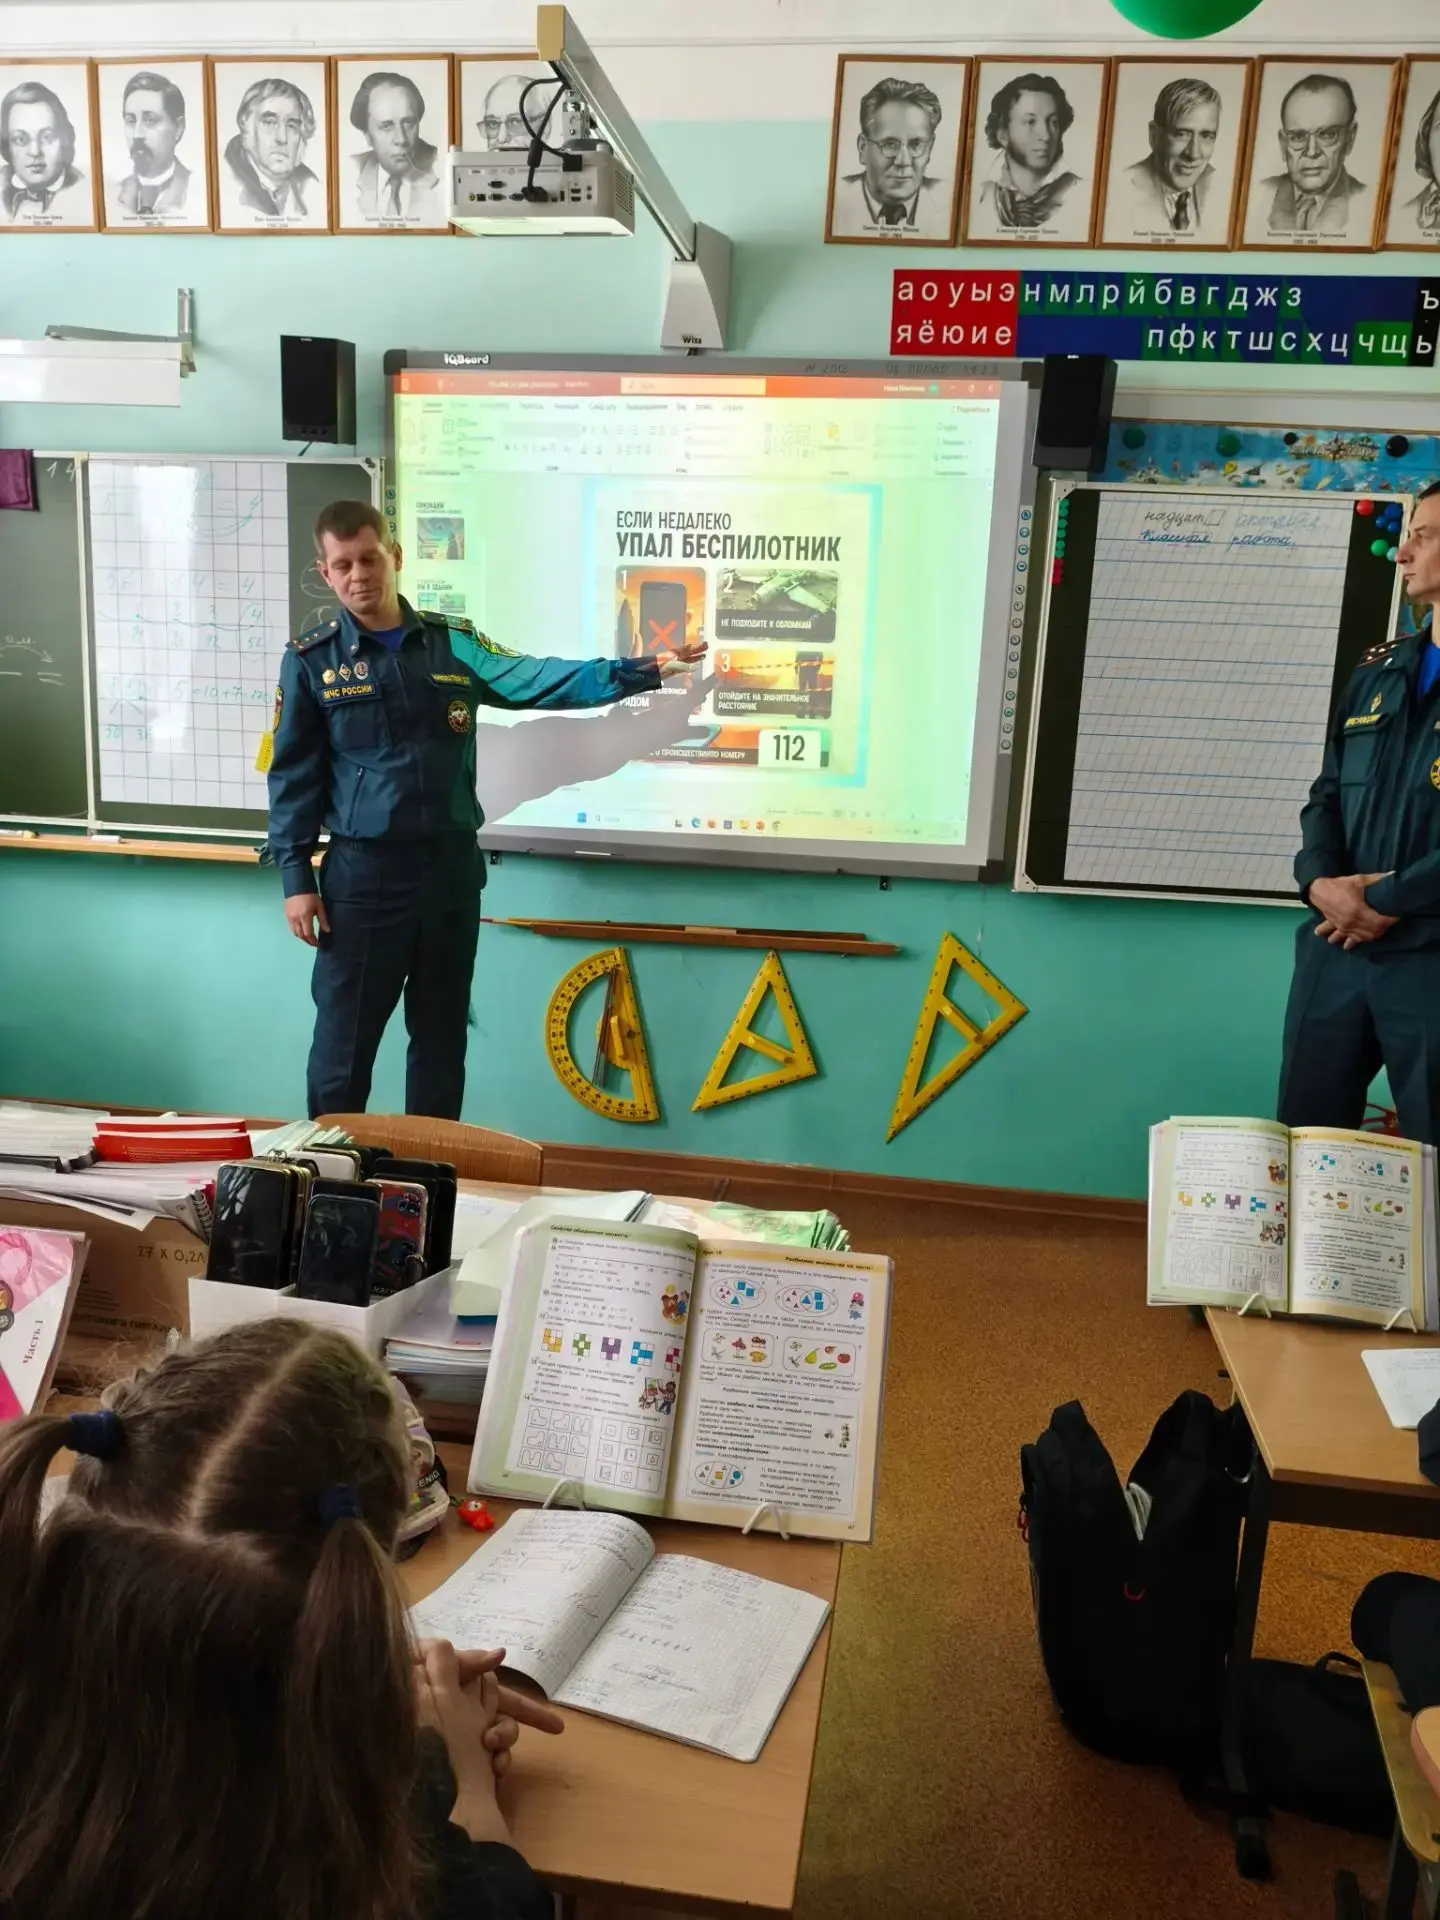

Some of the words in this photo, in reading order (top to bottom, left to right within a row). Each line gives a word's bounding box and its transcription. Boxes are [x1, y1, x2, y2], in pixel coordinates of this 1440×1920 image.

[616, 511, 653, 529] ЕСЛИ
[658, 511, 732, 531] НЕДАЛЕКО
[616, 532, 673, 558] УПАЛ
[682, 533, 841, 562] БЕСПИЛОТНИК
[621, 569, 628, 591] 1
[723, 573, 734, 593] 2
[721, 619, 730, 627] НЕ
[731, 619, 768, 629] ПОДХОДИТЕ
[769, 620, 774, 628] К
[775, 620, 812, 629] ОБЛОМКАМ
[720, 653, 731, 672] 3
[324, 688, 341, 700] МЧС
[342, 683, 373, 697] РОССИИ
[718, 691, 751, 701] ОТОЙДИТЕ
[753, 693, 761, 701] НА
[763, 693, 810, 703] ЗНАЧИТЕЛЬНОЕ
[718, 702, 757, 711] РАССТОЯНИЕ
[773, 734, 806, 762] 112
[22, 1328, 42, 1364] Часть
